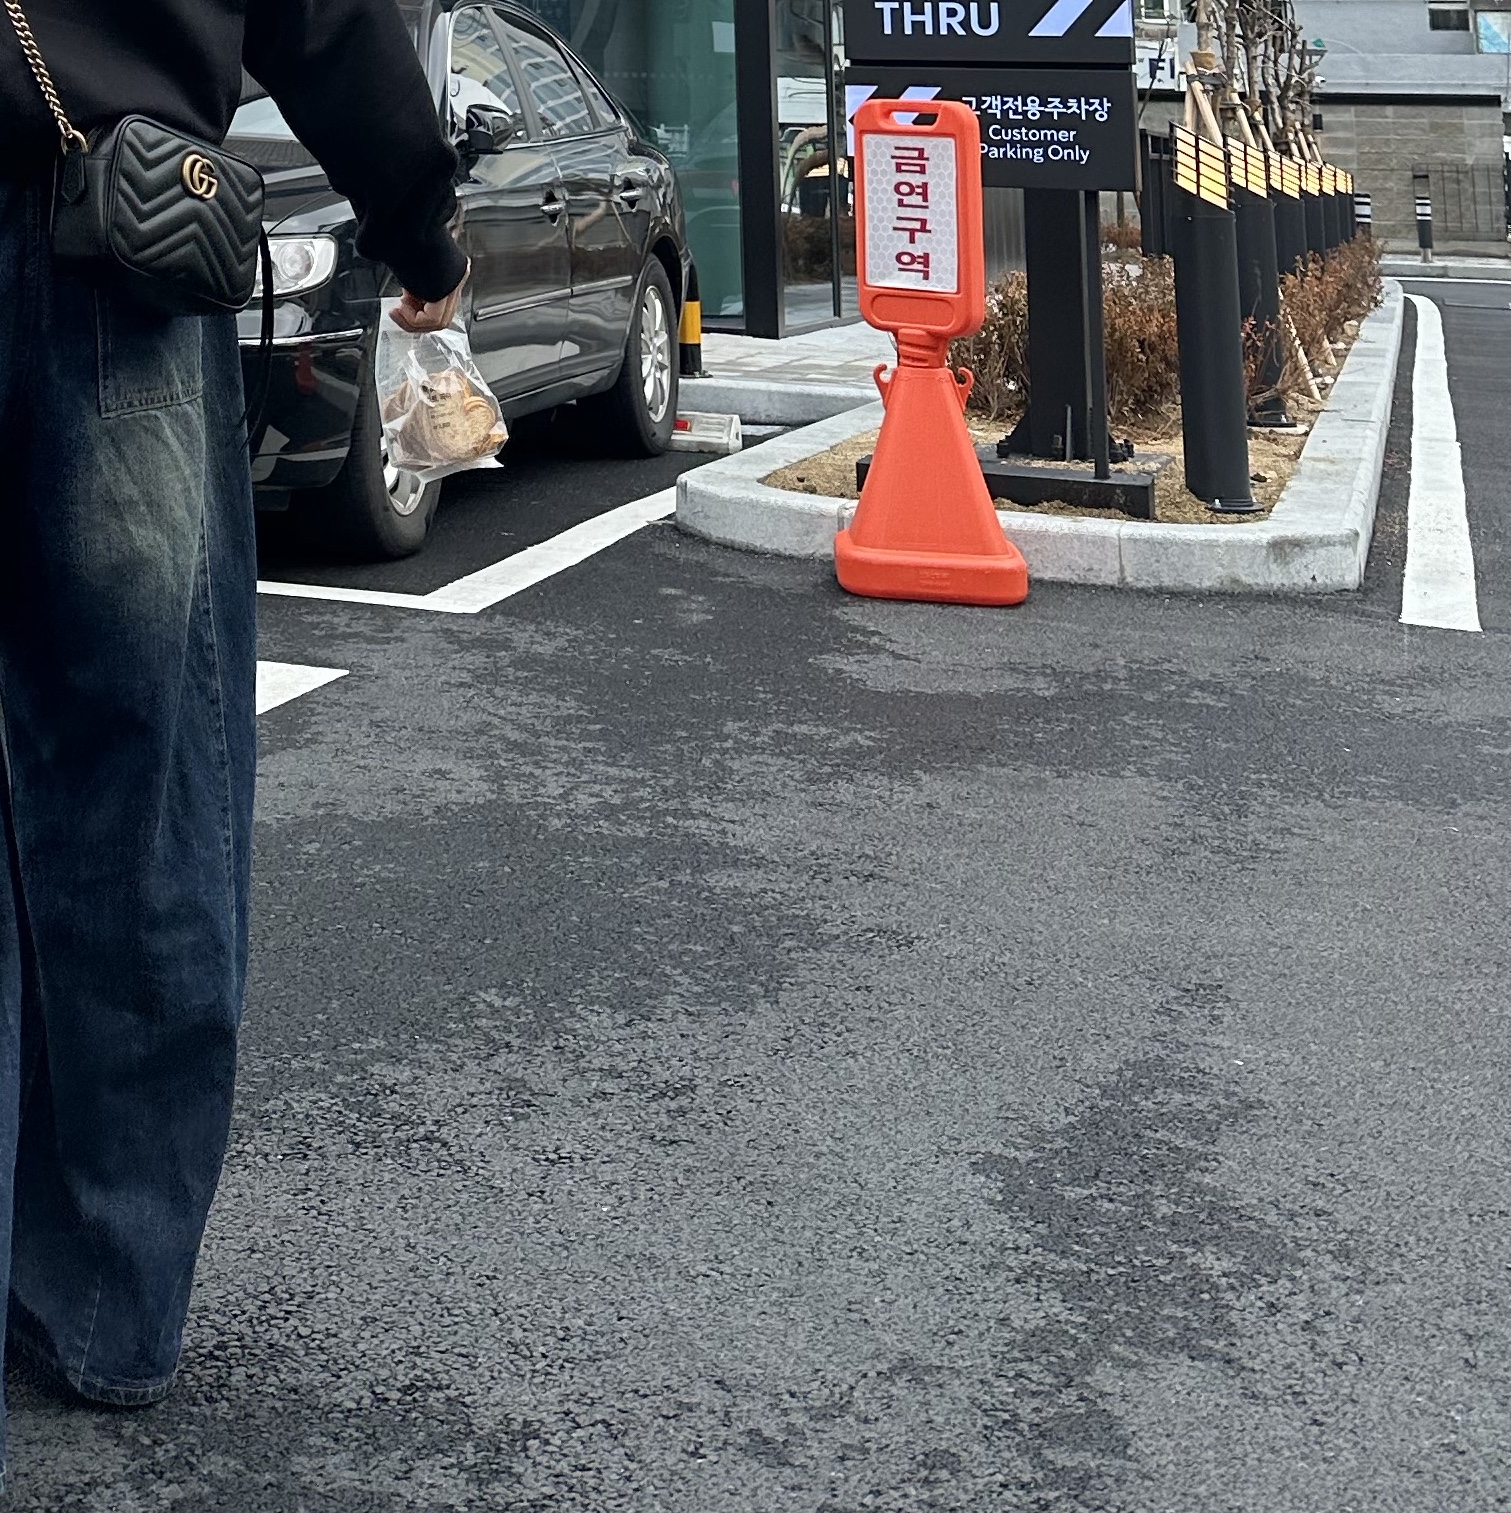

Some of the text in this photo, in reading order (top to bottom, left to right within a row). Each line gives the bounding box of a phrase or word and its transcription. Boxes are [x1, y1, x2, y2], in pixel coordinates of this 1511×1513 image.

[874, 0, 1001, 37] THRU
[988, 125, 1077, 143] Customer
[979, 143, 1091, 165] Parking Only
[890, 145, 932, 282] 금연구역
